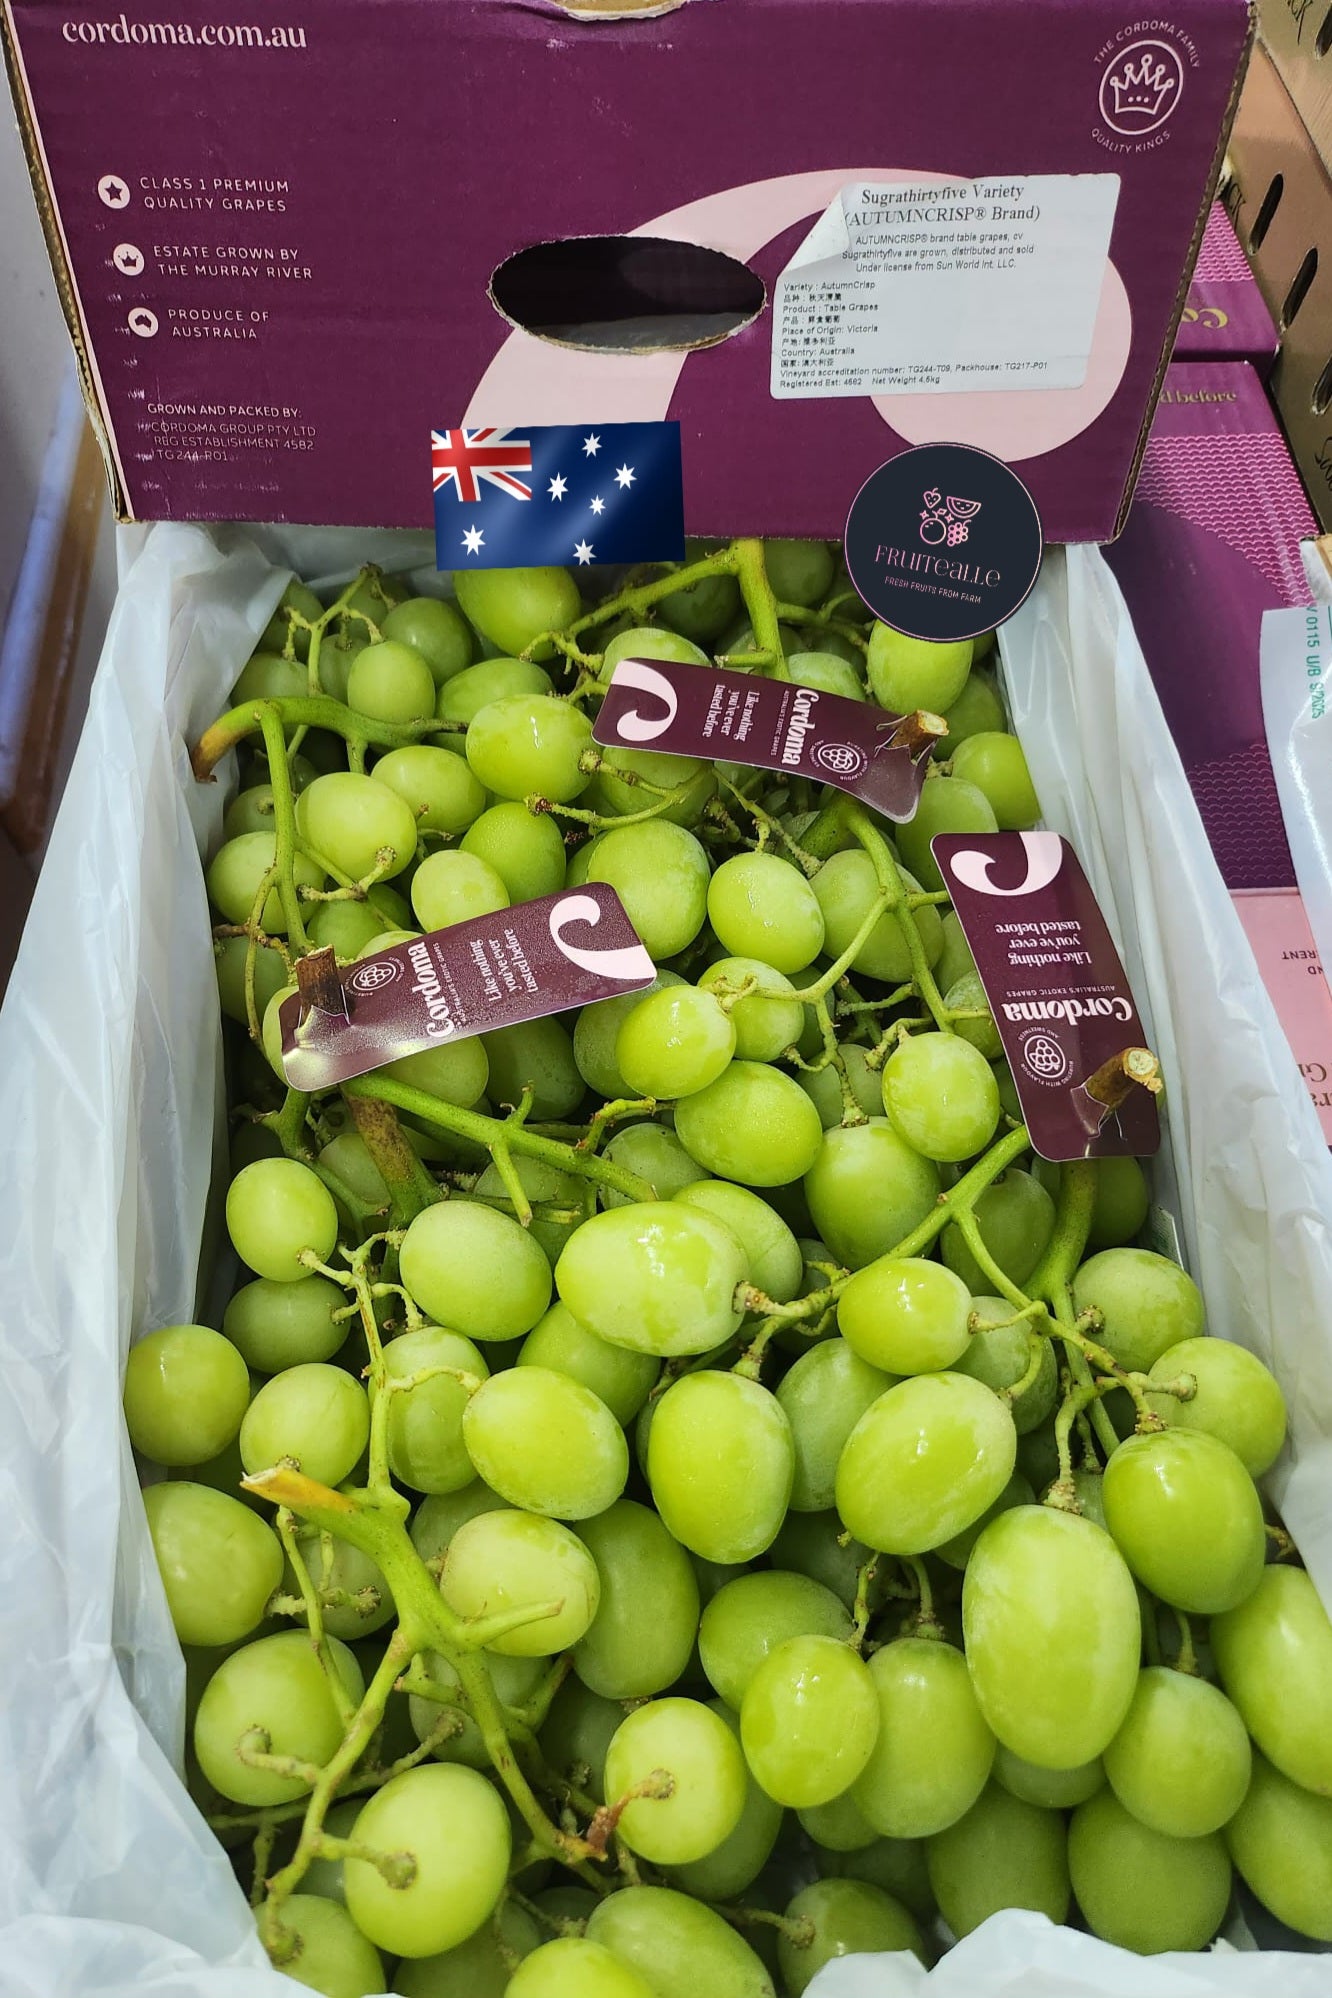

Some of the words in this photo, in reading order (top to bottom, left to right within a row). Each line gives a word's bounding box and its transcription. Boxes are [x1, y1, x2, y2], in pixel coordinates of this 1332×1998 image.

[61, 14, 307, 48] cordoma.com.au
[1094, 40, 1115, 64] THE
[1116, 20, 1176, 42] CORDOMA
[1176, 30, 1200, 68] FAMILY
[1091, 128, 1132, 153] QUALITY
[1135, 130, 1171, 153] KINGS
[140, 177, 193, 190] CLASS
[199, 178, 207, 190] 1
[213, 178, 289, 193] PREMIUM
[861, 187, 967, 207] Sugrathirtyfive
[972, 184, 1025, 201] Variety
[144, 196, 214, 210] QUALITY
[222, 198, 287, 212] GRAPES
[991, 205, 1041, 221] Brand)
[930, 233, 955, 243] brand
[956, 232, 977, 242] table
[153, 245, 210, 258] ESTATE
[216, 247, 275, 260] GROWN
[280, 249, 299, 261] BY
[842, 248, 902, 261] Sugrathirtyfive
[904, 250, 918, 258] are
[951, 245, 996, 256] distributed
[998, 245, 1014, 255] and
[1016, 244, 1035, 254] sold
[158, 264, 189, 276] THE
[195, 265, 259, 278] MURRAY
[266, 266, 313, 279] RIVER
[856, 262, 882, 272] Under
[883, 260, 913, 271] license
[914, 260, 934, 270] from
[936, 260, 953, 270] Sun
[955, 259, 980, 269] World
[783, 283, 813, 292] Variety
[168, 309, 244, 322] PRODUCE
[250, 311, 270, 323] OF
[782, 305, 816, 314] Product
[824, 304, 846, 312] Table
[848, 303, 879, 312] Grapes
[172, 327, 257, 339] AUSTRALIA
[781, 327, 804, 336] Place
[806, 327, 815, 335] of
[847, 325, 878, 333] Victoria
[819, 347, 855, 356] Australia
[780, 369, 816, 379] Vineyard
[817, 368, 870, 377] accreditation
[780, 379, 823, 389] Registered
[871, 377, 886, 385] Net
[888, 375, 917, 385] Weight
[147, 403, 196, 415] GROWN
[200, 404, 226, 416] AND
[229, 405, 279, 418] PACKED
[151, 421, 217, 434] CORDOMA
[219, 422, 264, 435] GROUP
[267, 424, 291, 435] PTY
[293, 425, 316, 437] LTD
[181, 437, 279, 449] ESTABLISHMENT
[711, 684, 726, 710] tasted
[725, 689, 741, 715] you've
[744, 690, 760, 708] Like
[702, 709, 721, 738] before
[720, 715, 734, 736] ever
[733, 707, 754, 742] nothing
[782, 688, 820, 766] Cordoma
[994, 922, 1040, 936] before
[1039, 920, 1082, 935] tasted
[488, 939, 505, 960] ever
[503, 928, 525, 966] before
[1008, 938, 1038, 949] ever
[1039, 933, 1081, 950] you've
[469, 939, 493, 977] nothing
[1007, 952, 1061, 968] nothing
[1062, 951, 1093, 965] Like
[1281, 950, 1318, 960] RENT
[498, 959, 523, 992] you've
[518, 960, 539, 993] tasted
[407, 941, 455, 1038] Cordoma
[484, 977, 502, 1002] Like
[1006, 989, 1038, 998] GRAPES
[1039, 987, 1067, 995] EXOTIC
[1001, 996, 1133, 1026] Cordoma
